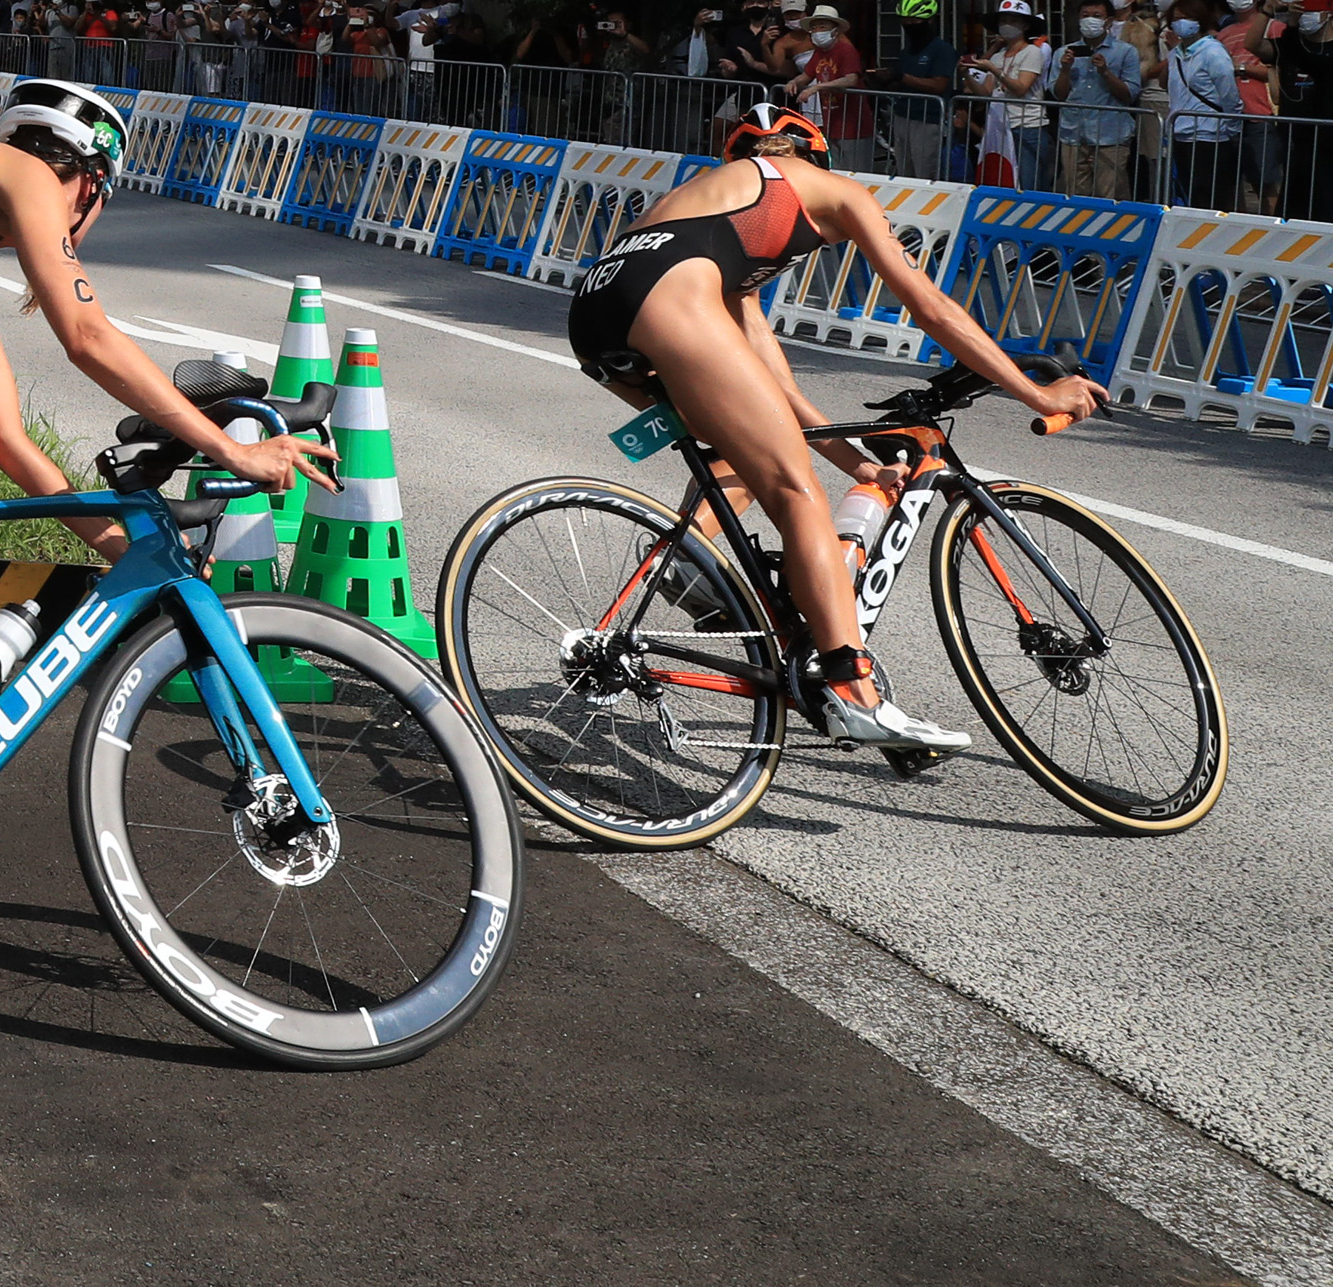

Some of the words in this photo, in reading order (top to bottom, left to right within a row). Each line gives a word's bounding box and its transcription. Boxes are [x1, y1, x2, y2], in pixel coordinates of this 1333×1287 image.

[73, 278, 94, 303] C
[579, 258, 626, 298] NED
[643, 416, 669, 439] 7C
[103, 667, 143, 734] BOYD
[99, 829, 285, 1037] BOYD
[469, 905, 504, 977] BOYD
